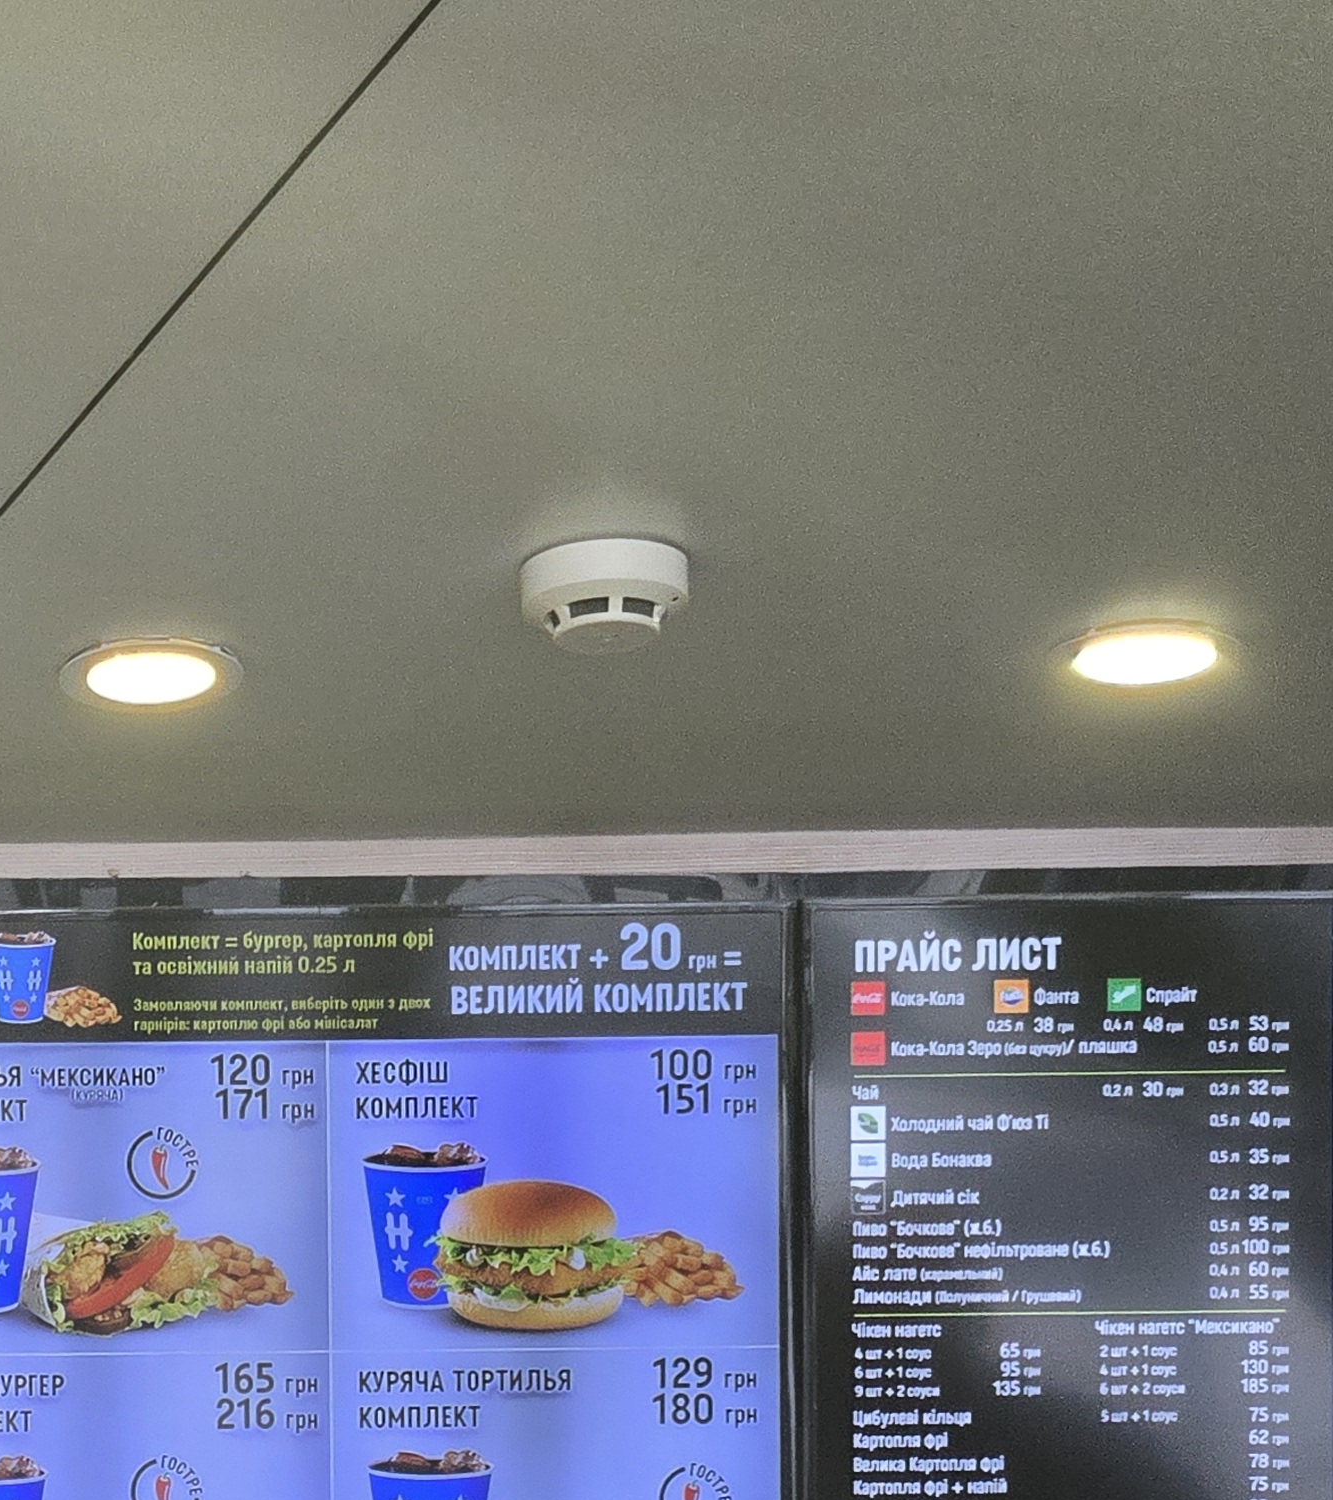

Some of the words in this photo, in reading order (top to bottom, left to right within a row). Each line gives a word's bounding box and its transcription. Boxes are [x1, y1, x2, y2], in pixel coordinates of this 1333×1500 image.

[854, 932, 962, 973] ПРАЙС
[971, 937, 1062, 971] ЛИСТ
[891, 991, 965, 1007] Кока-Кола
[1034, 989, 1079, 1006] Фанта
[1146, 987, 1197, 1006] Спрайт
[211, 1055, 270, 1085] 120
[282, 1066, 314, 1087] грн
[356, 1060, 449, 1084] ХЕСФІШ
[651, 1050, 712, 1080] 100
[724, 1061, 757, 1083] грн
[852, 1084, 878, 1099] Чай
[891, 1115, 963, 1135] Холодний
[969, 1115, 993, 1130] чай
[156, 1126, 200, 1169] ГОСТРЕ
[891, 1153, 928, 1169] Вода
[932, 1152, 992, 1168] Бонаква
[891, 1190, 954, 1208] Дитячий
[958, 1189, 980, 1205] сік
[852, 1322, 889, 1338] Чікен
[891, 1323, 942, 1338] нагетс
[215, 1364, 274, 1394] 165
[286, 1375, 318, 1397] грн
[358, 1370, 444, 1394] КУРЯЧА
[452, 1370, 572, 1392] ТОРТИЛЬЯ
[652, 1358, 712, 1388] 129
[724, 1369, 757, 1392] грн
[852, 1410, 919, 1428] Цибулеві
[922, 1410, 971, 1426] кільця
[853, 1432, 920, 1450] Картопля
[923, 1431, 948, 1451] фрі
[160, 1455, 204, 1498] ГОСТРЕ
